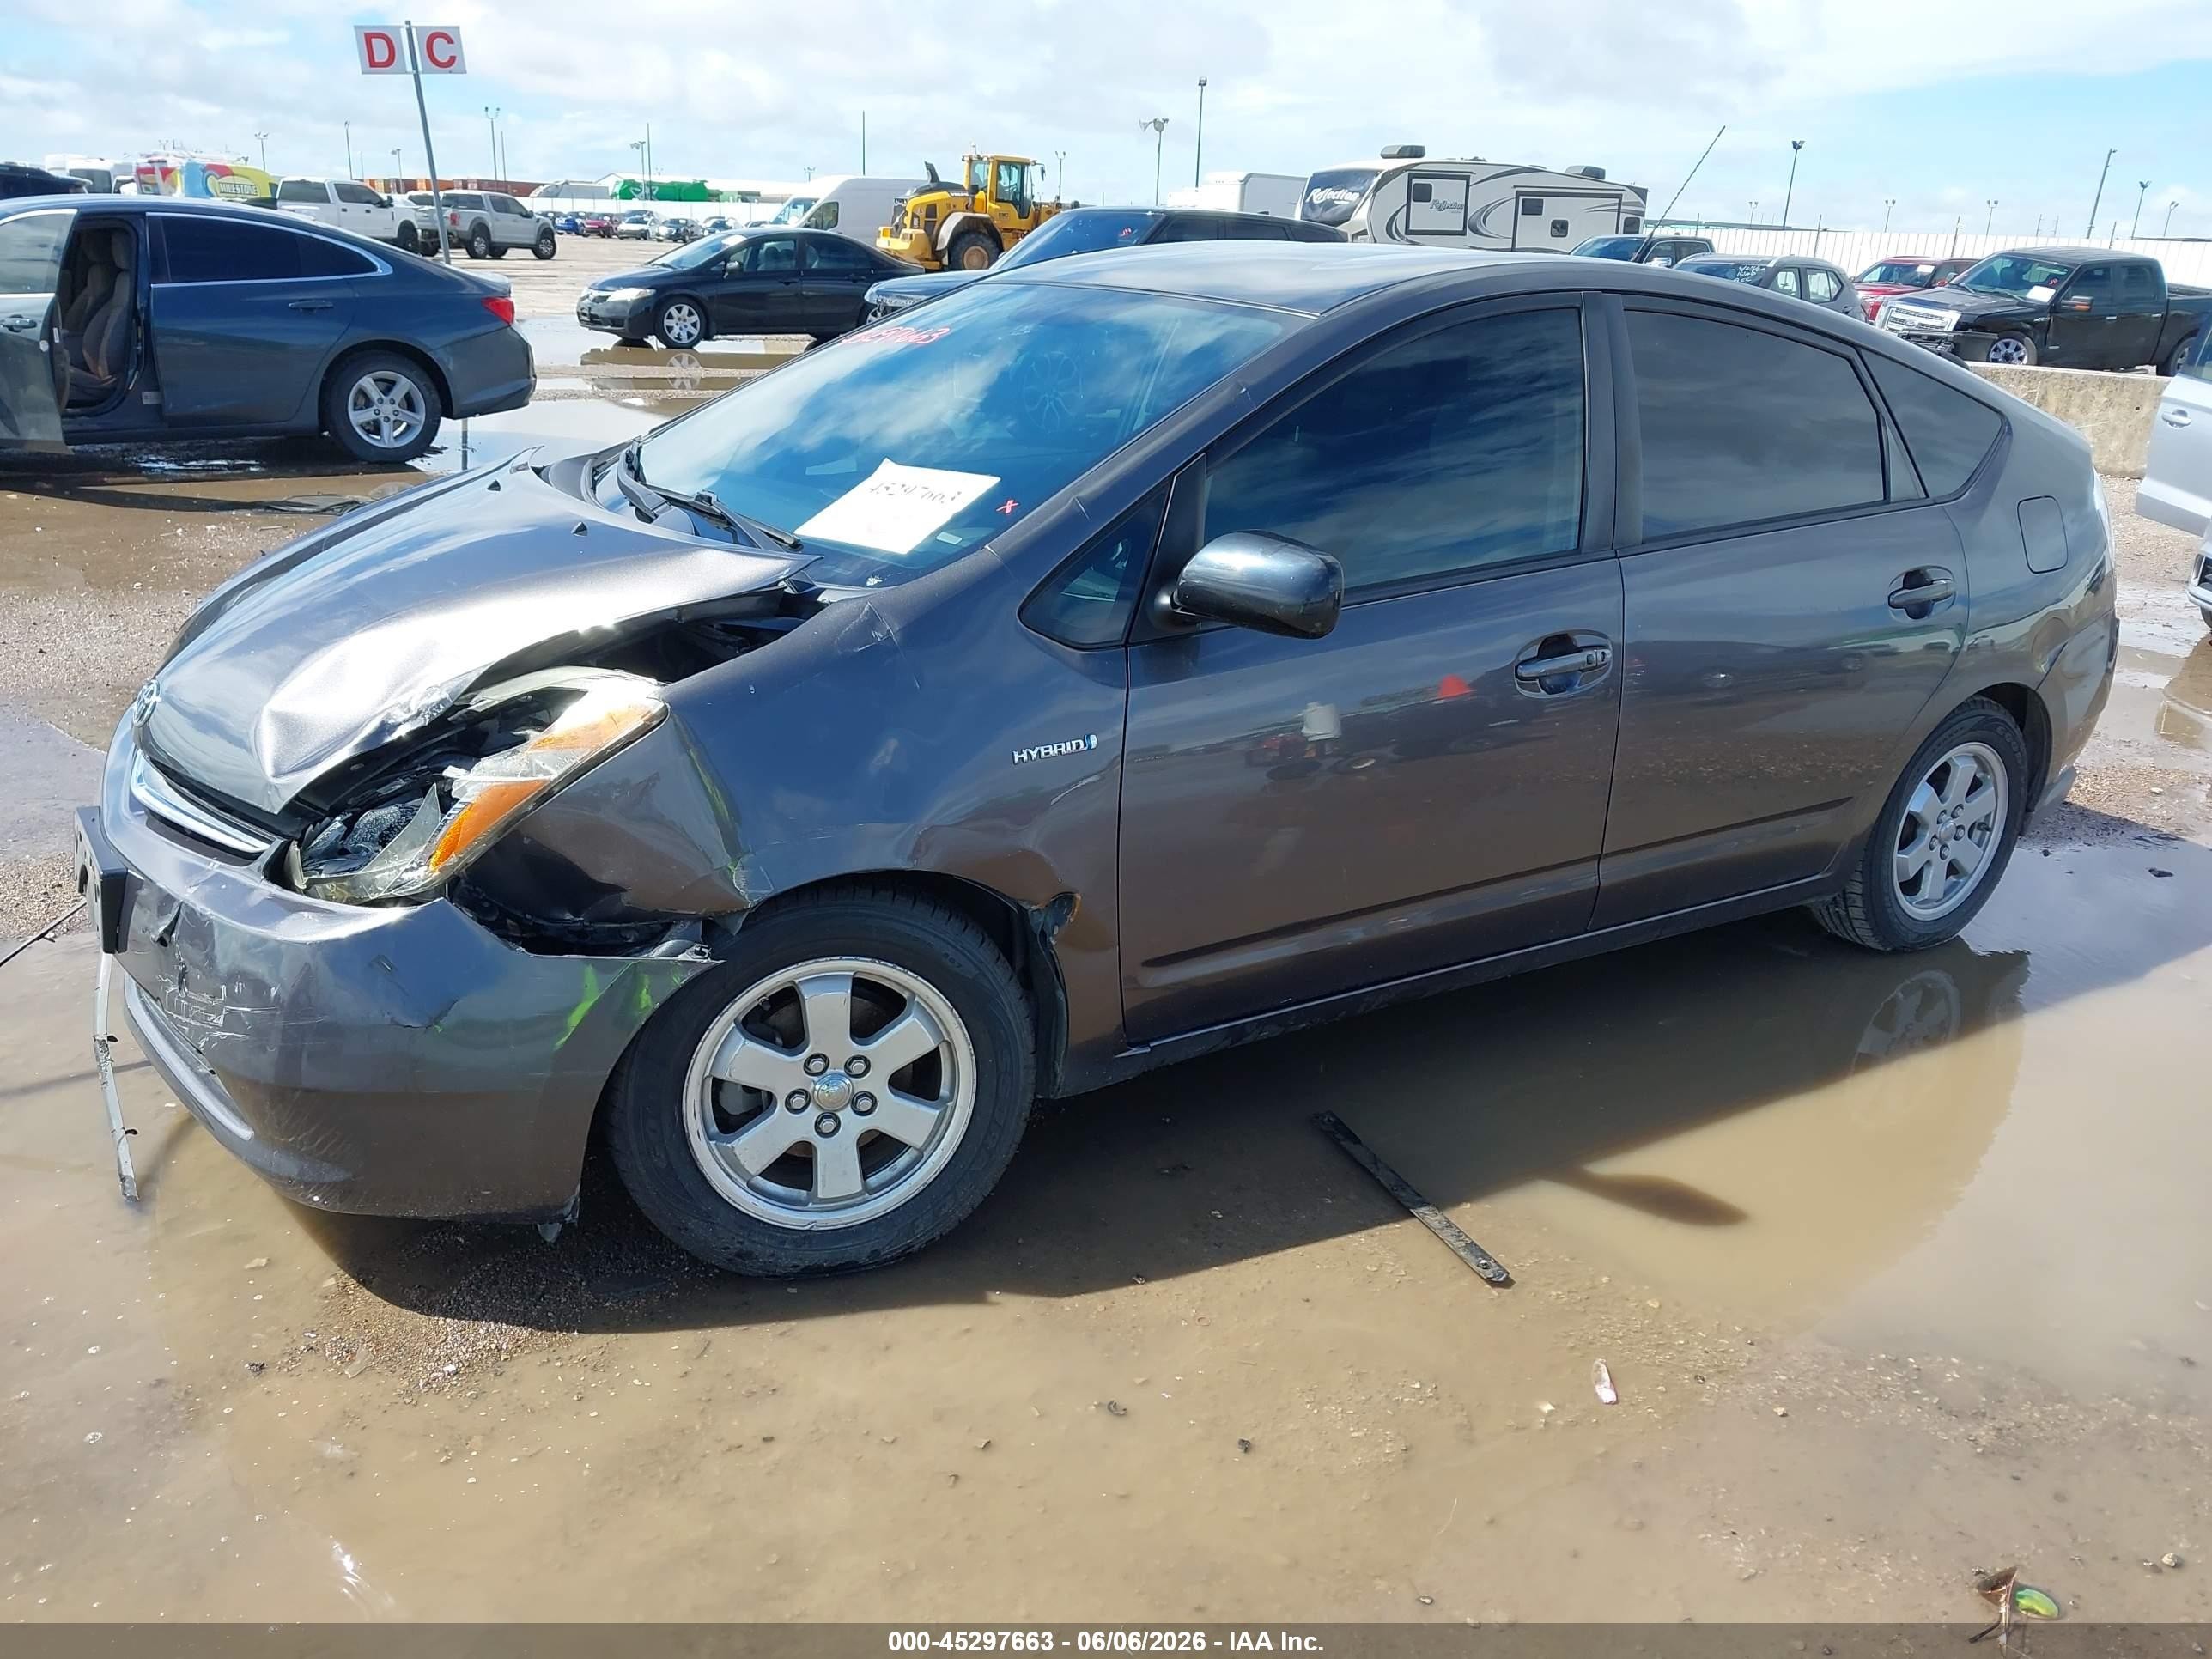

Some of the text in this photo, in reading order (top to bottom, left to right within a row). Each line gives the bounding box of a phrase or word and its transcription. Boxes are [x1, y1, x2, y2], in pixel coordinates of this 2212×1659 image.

[363, 32, 396, 68] D
[425, 31, 457, 69] C
[219, 183, 258, 195] MILESTONE
[1305, 187, 1360, 204] Reflection
[1429, 198, 1463, 212] Reflection
[1013, 738, 1086, 764] HYBRID
